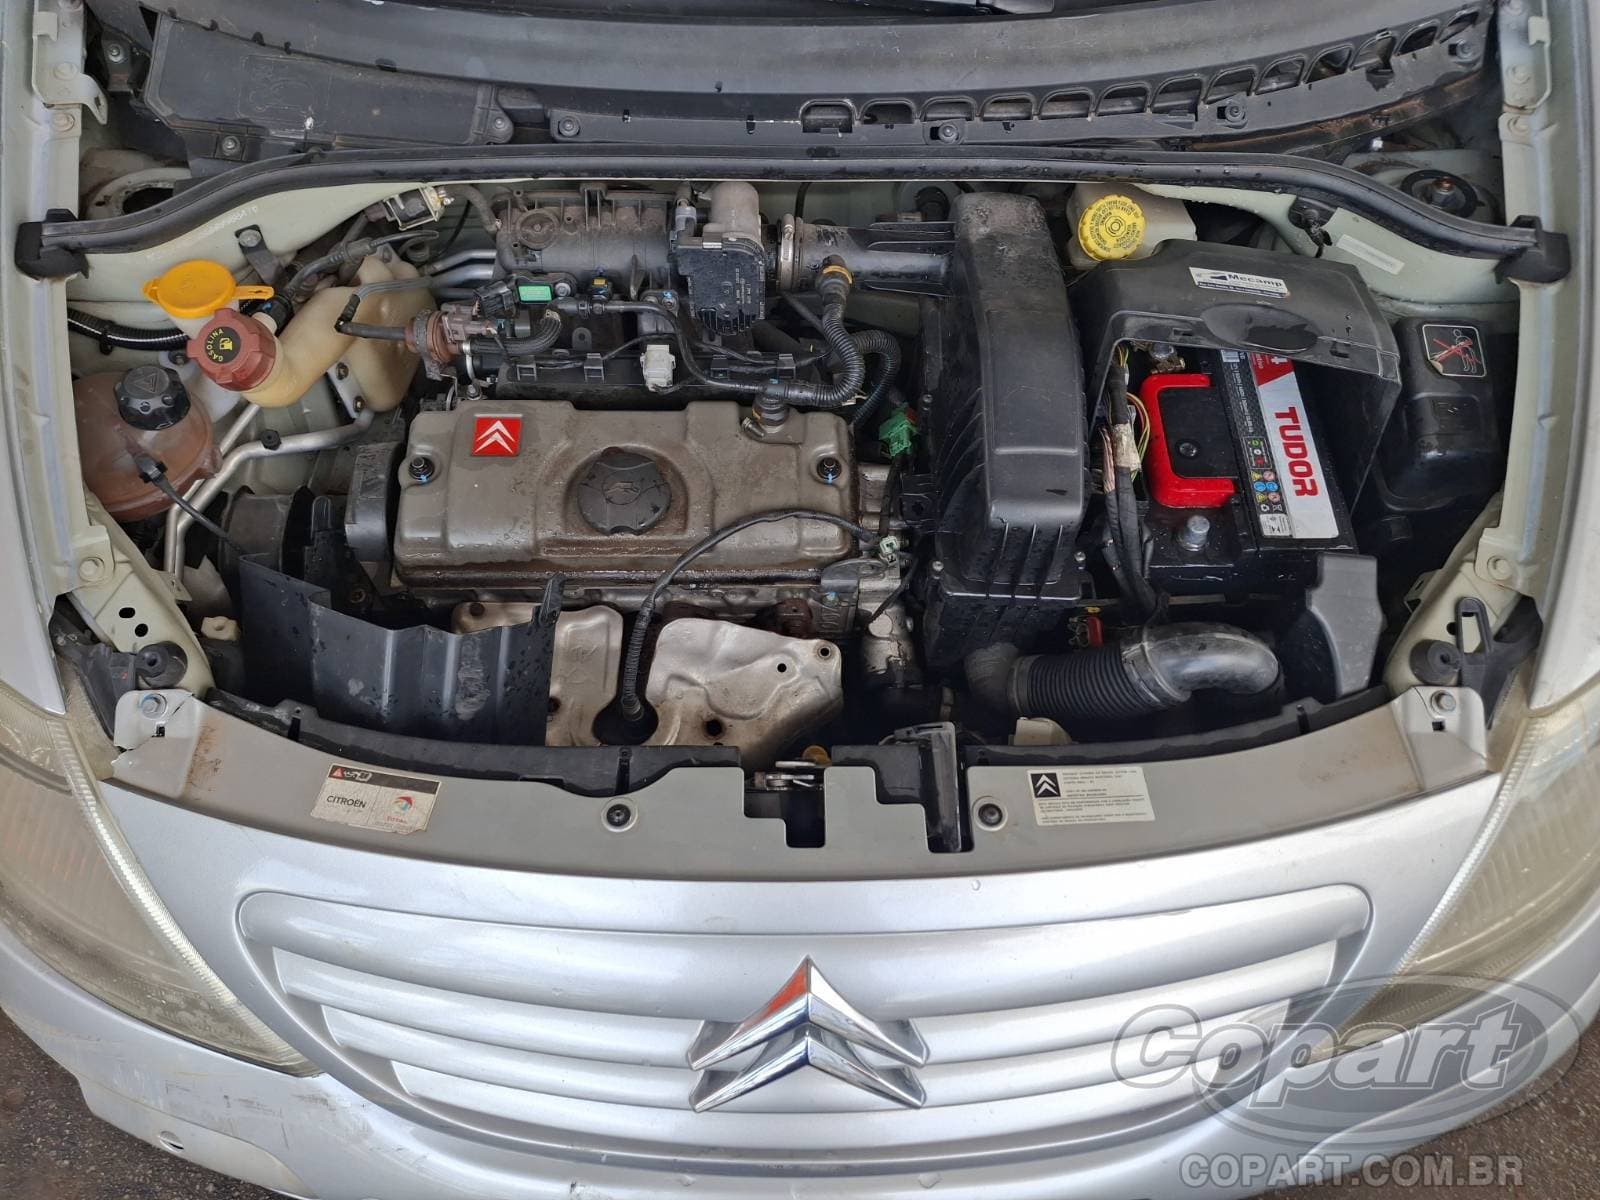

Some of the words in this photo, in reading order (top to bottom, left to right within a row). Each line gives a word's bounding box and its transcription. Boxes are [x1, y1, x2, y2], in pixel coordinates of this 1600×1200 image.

[1228, 273, 1282, 288] Mecamp
[206, 328, 224, 362] GASOLINA
[1274, 406, 1319, 497] TUDOR
